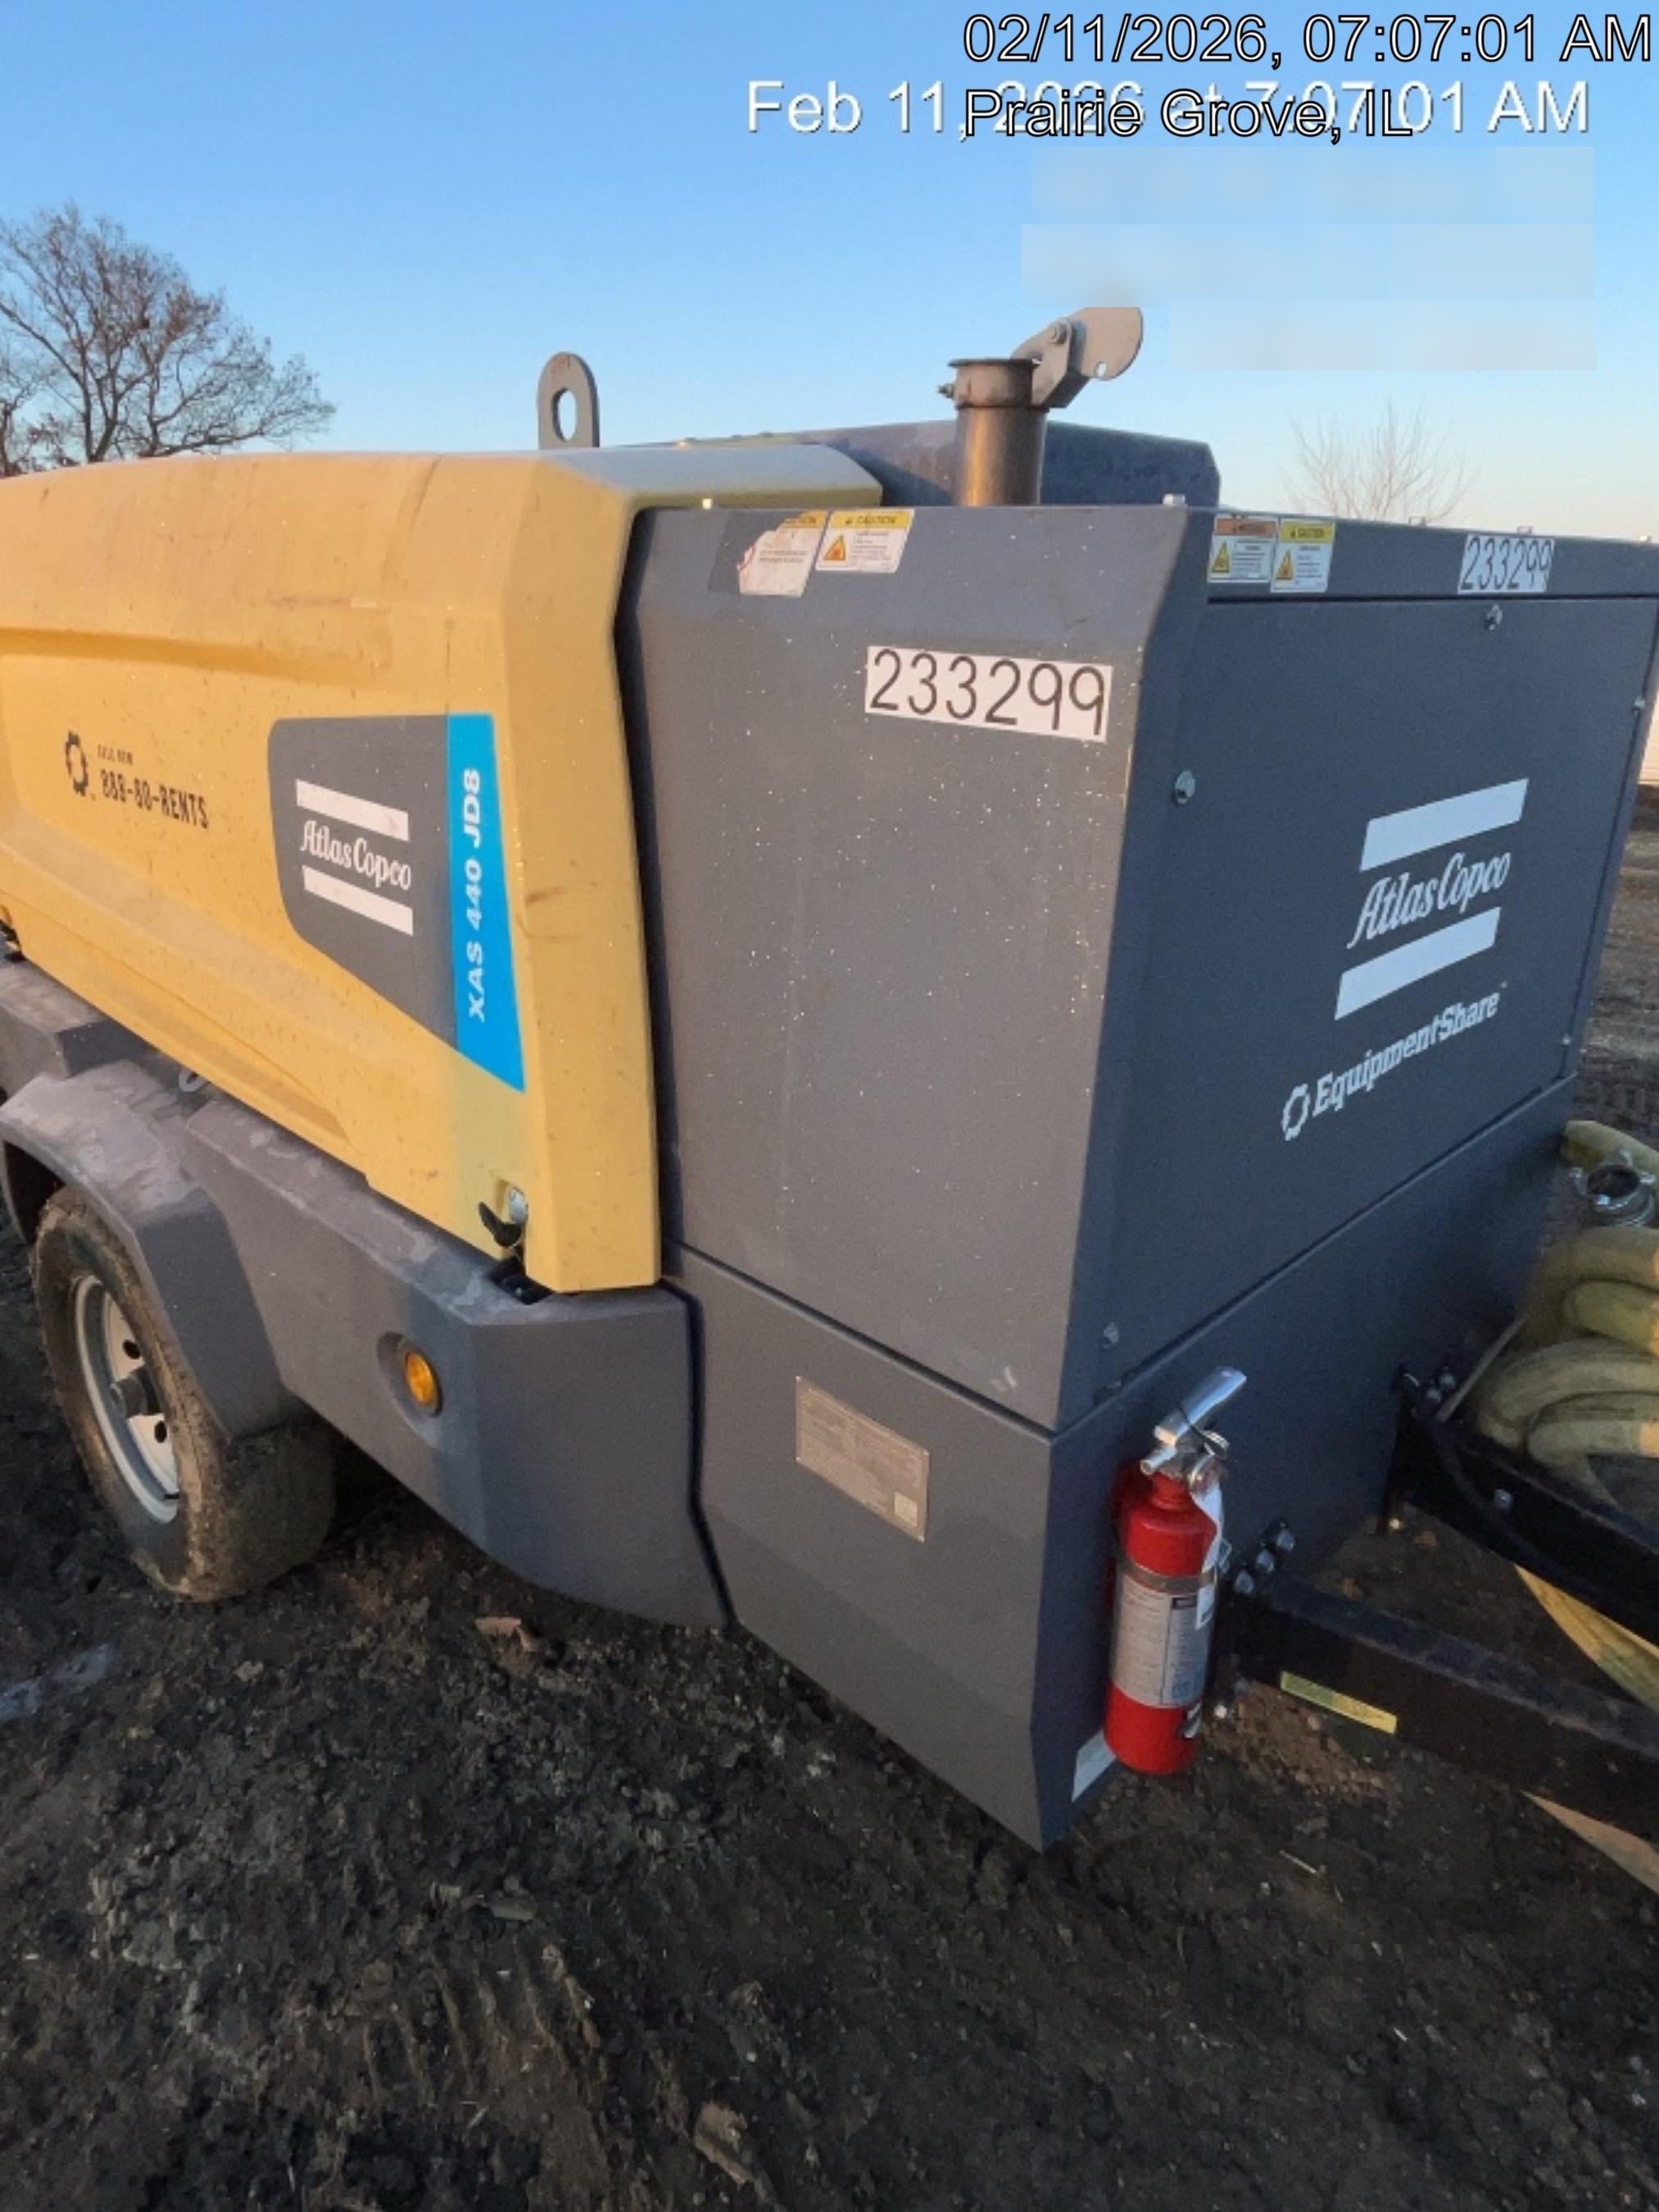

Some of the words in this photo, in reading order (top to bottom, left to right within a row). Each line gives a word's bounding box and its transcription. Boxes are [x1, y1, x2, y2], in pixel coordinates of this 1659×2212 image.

[1459, 537, 1552, 590] 233299
[869, 649, 1105, 736] 233299
[463, 768, 482, 848] JD8
[464, 858, 483, 931] 440
[468, 941, 485, 1022] XAS
[1312, 992, 1500, 1117] EquipmentShare
